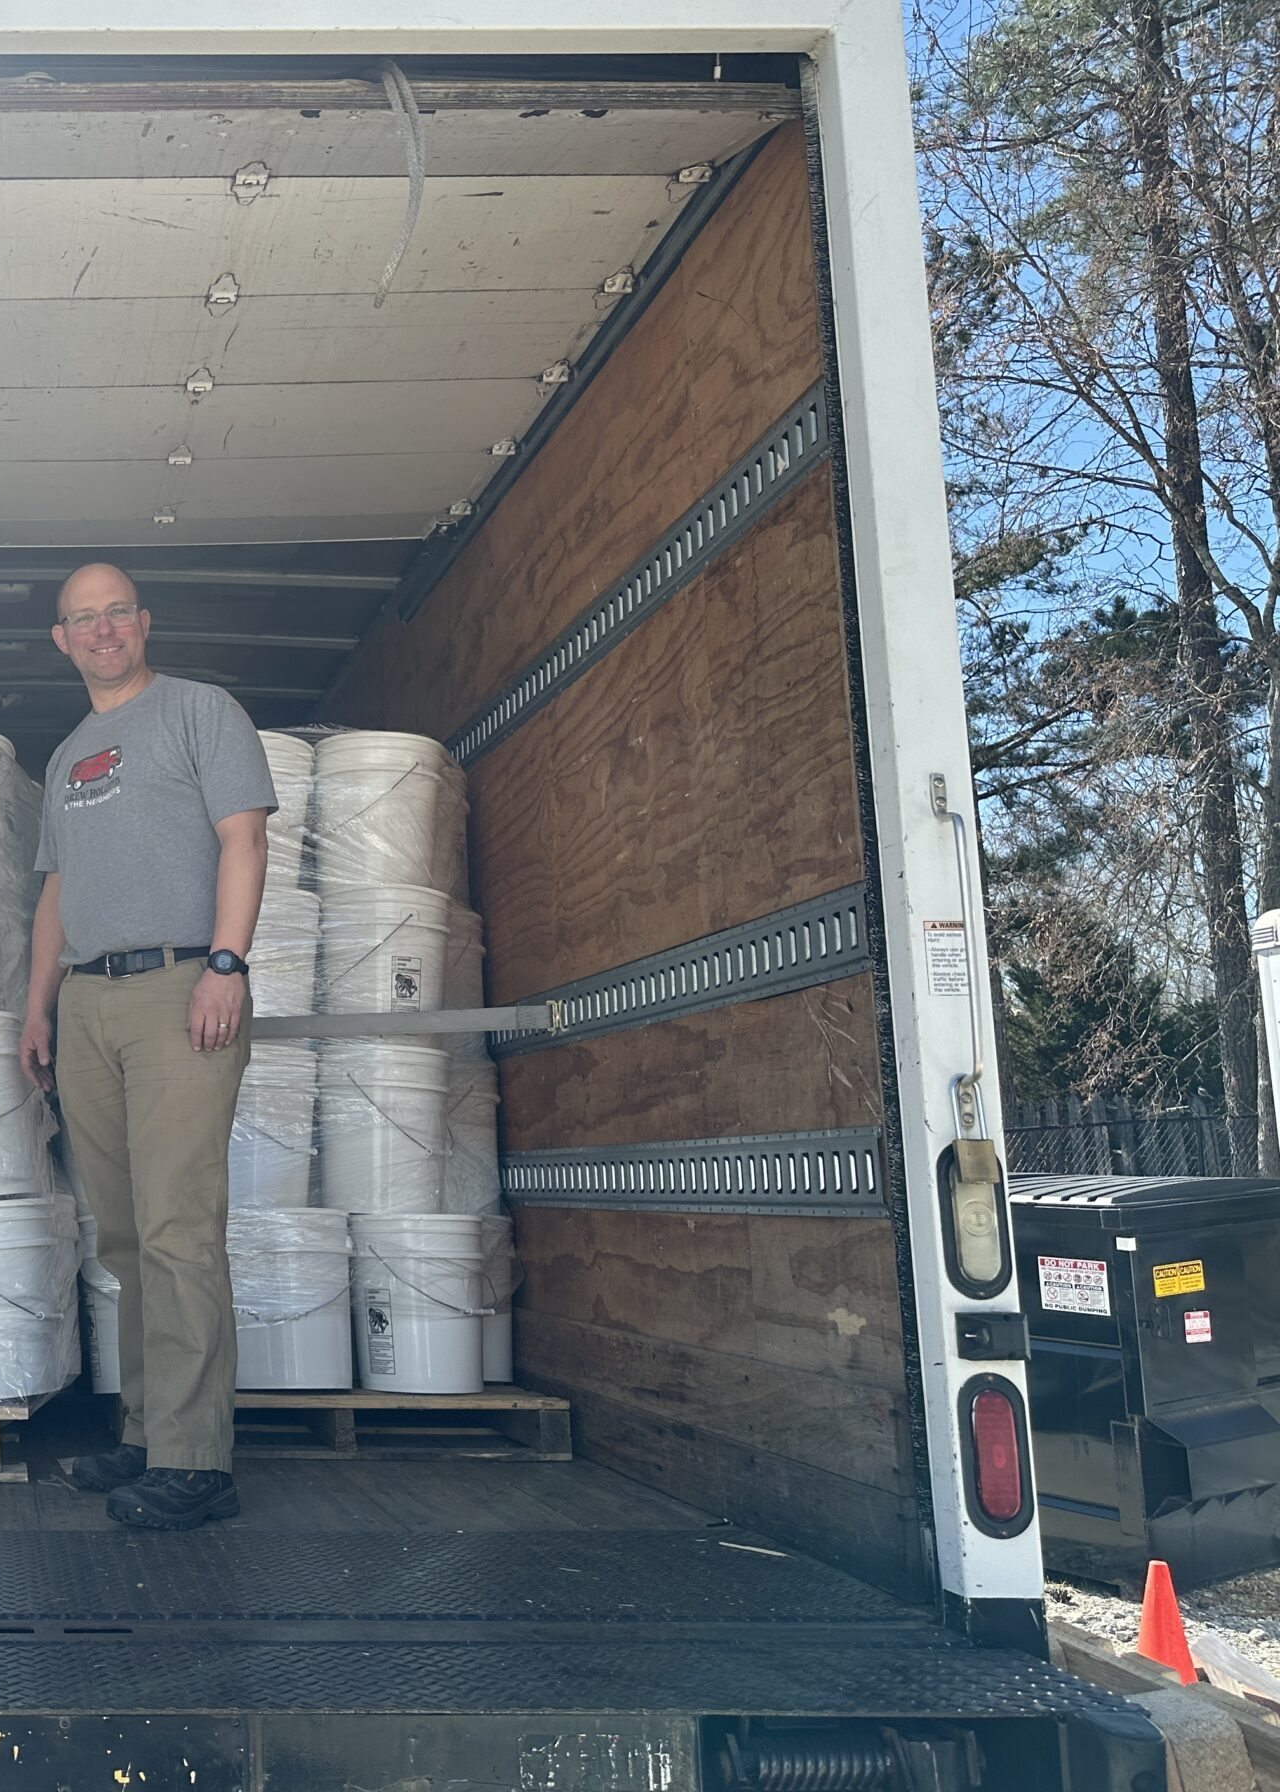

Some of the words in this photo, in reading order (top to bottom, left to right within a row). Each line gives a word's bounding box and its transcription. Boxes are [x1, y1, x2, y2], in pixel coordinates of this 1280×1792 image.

[70, 800, 85, 808] THE
[1044, 1259, 1056, 1267] DO
[1058, 1260, 1074, 1268] NOT
[1076, 1262, 1100, 1271] PARK
[1180, 1264, 1201, 1274] CAUTION
[1155, 1269, 1177, 1278] CAUTION
[1078, 1306, 1108, 1314] DUMPING
